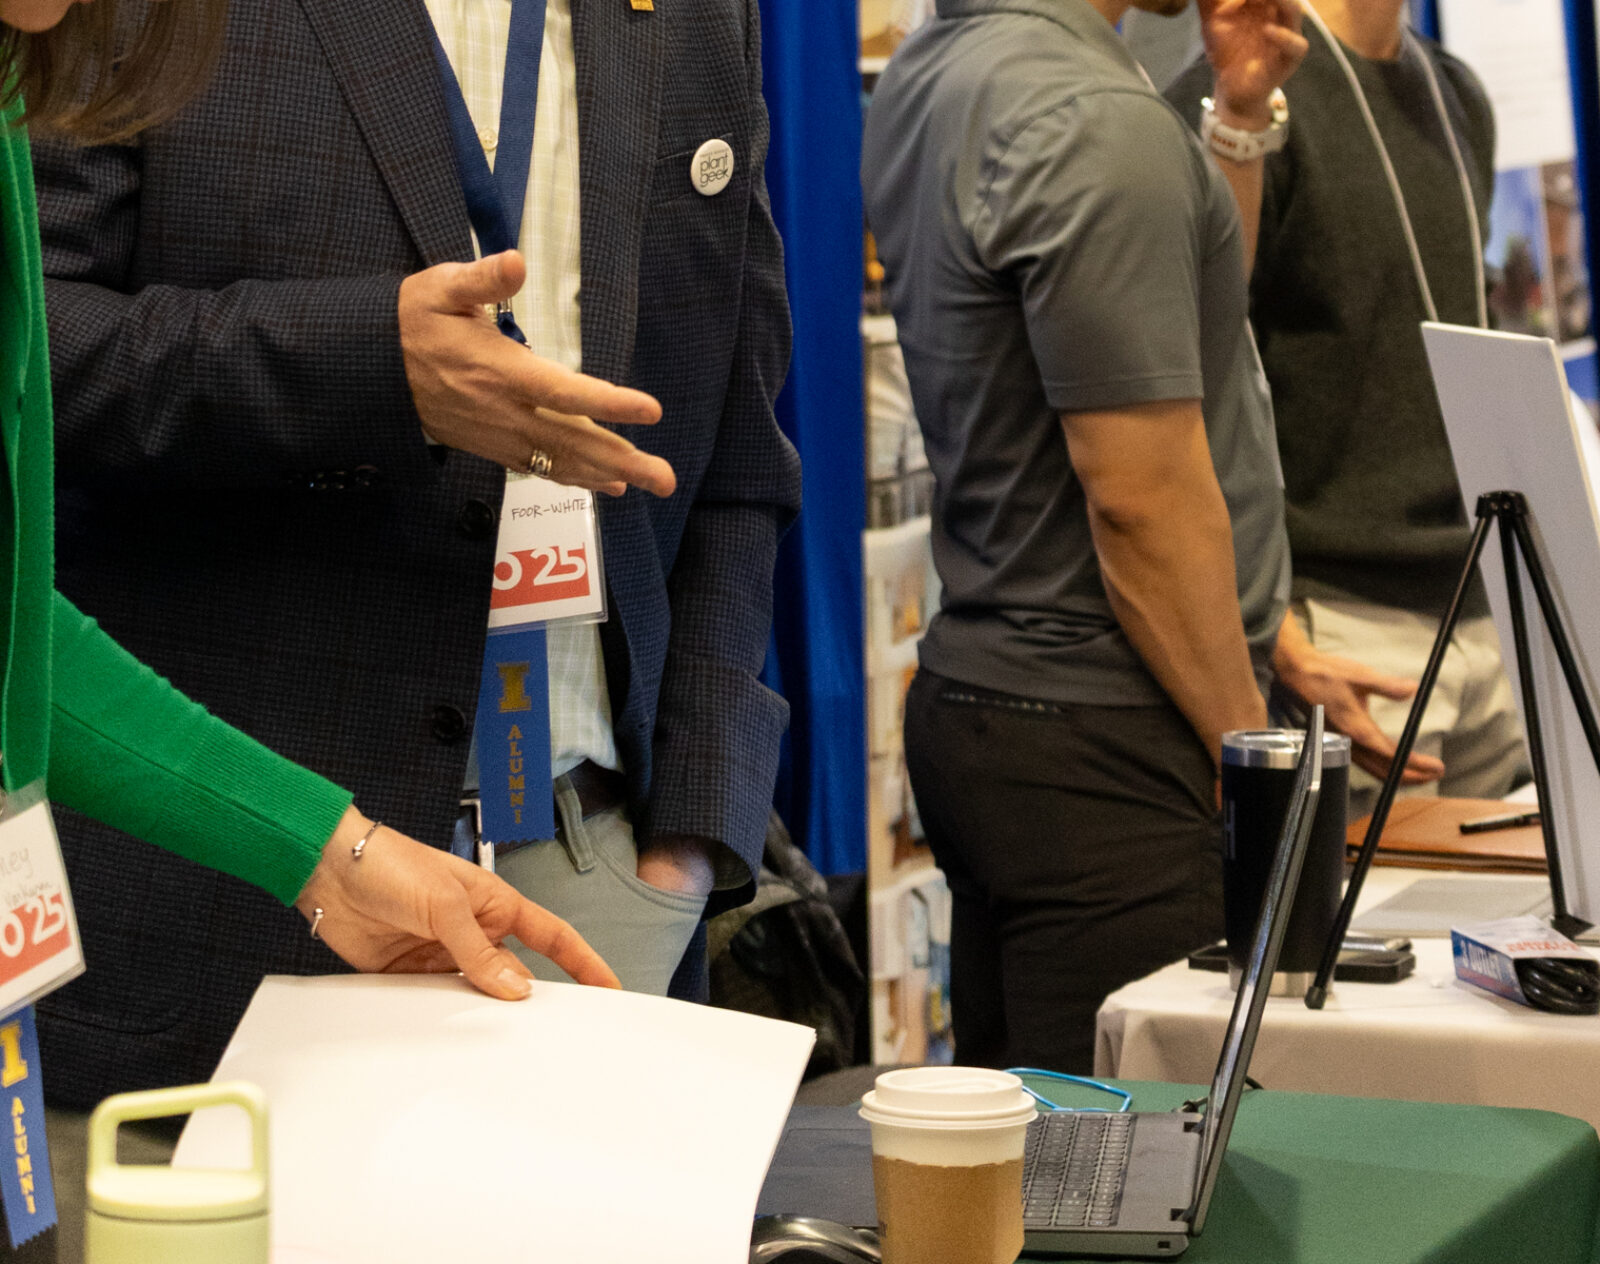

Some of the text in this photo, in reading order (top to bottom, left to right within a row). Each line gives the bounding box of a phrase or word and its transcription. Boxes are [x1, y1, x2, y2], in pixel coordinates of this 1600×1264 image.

[700, 152, 728, 174] plant
[700, 169, 730, 188] geek
[511, 498, 590, 521] FOOR-WHITE
[507, 724, 526, 825] ALUMNI
[11, 1096, 36, 1215] ALUMNI
